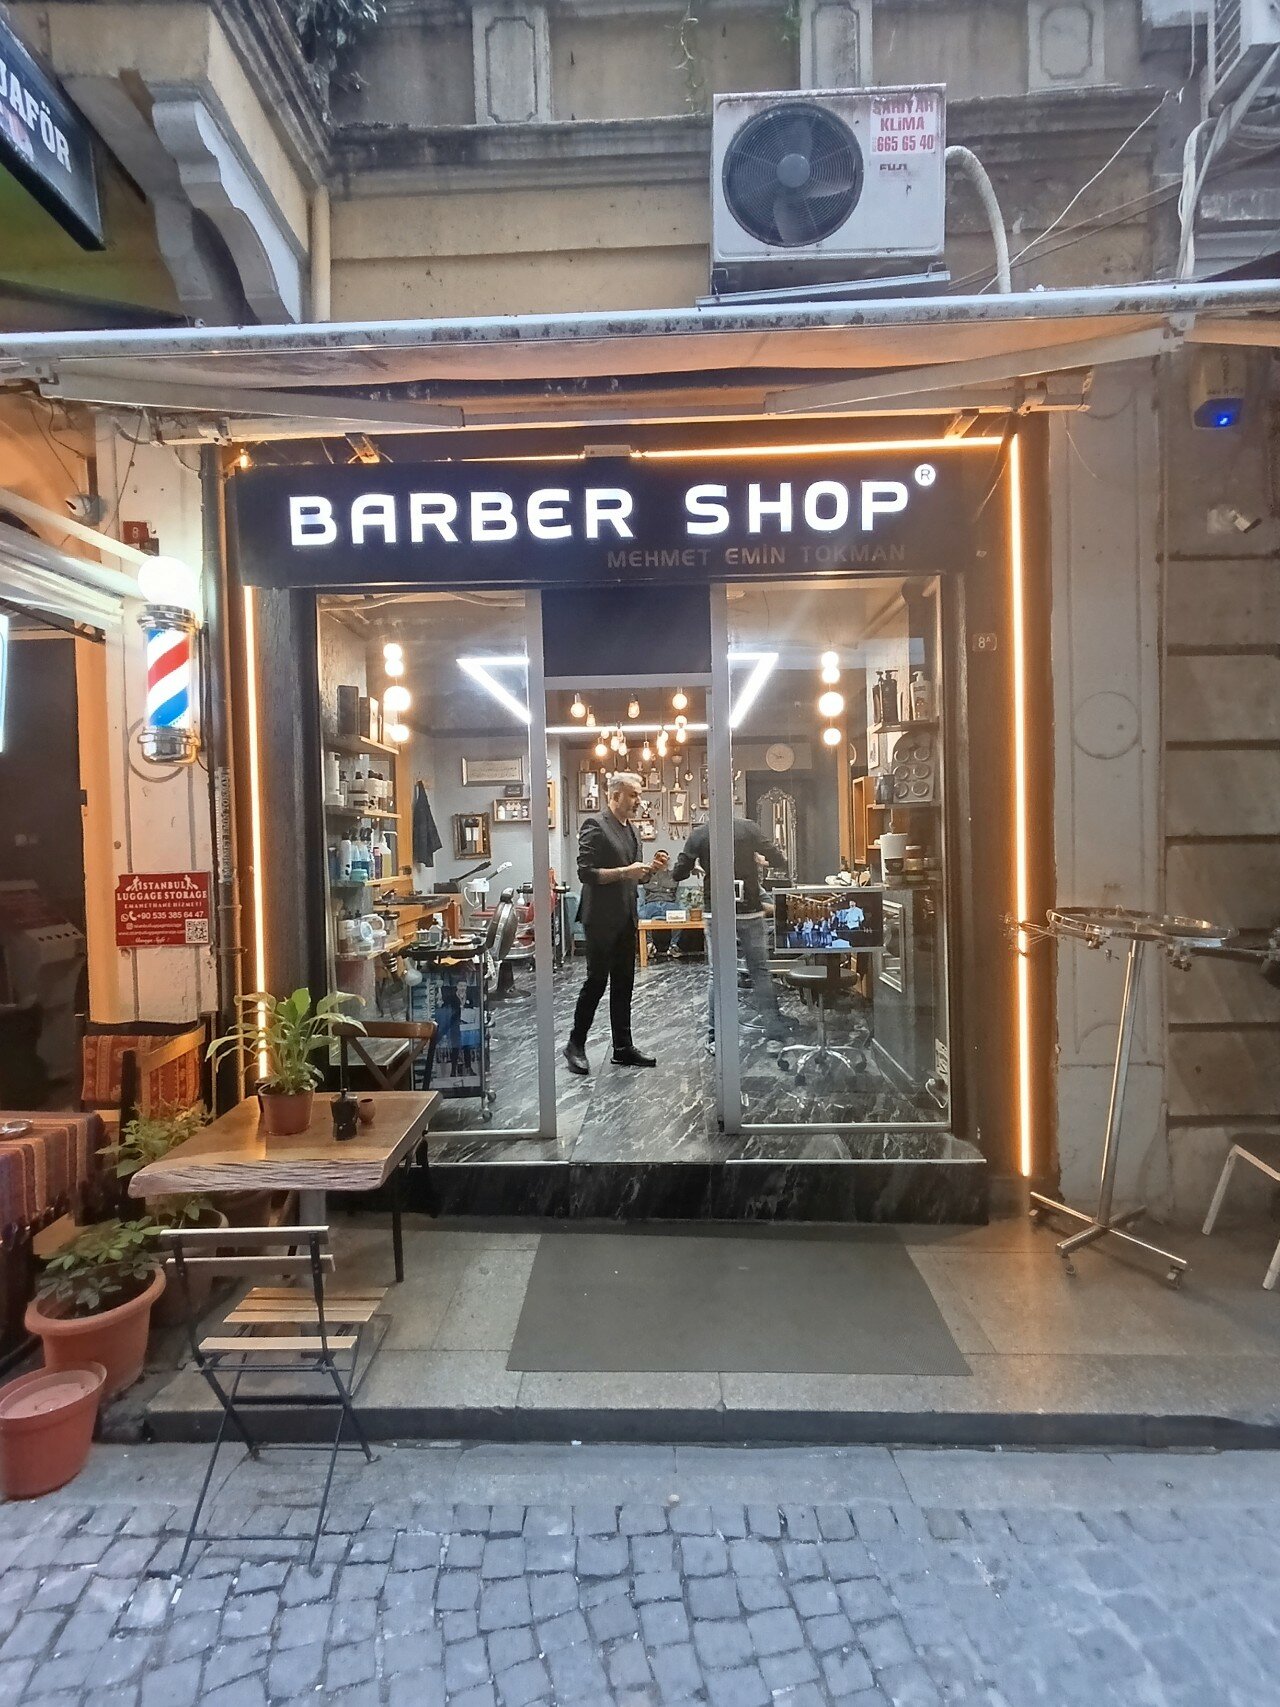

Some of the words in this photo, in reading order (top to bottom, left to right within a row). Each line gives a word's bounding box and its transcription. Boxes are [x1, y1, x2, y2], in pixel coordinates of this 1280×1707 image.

[877, 136, 899, 152] 665
[902, 135, 916, 151] 65
[919, 134, 934, 150] 40
[289, 488, 634, 546] BARBER
[684, 480, 909, 536] SHOP
[607, 549, 711, 568] MEHMET
[803, 544, 905, 564] TOKMAN
[117, 891, 162, 901] LUGGAGE
[164, 890, 207, 900] STORAGE
